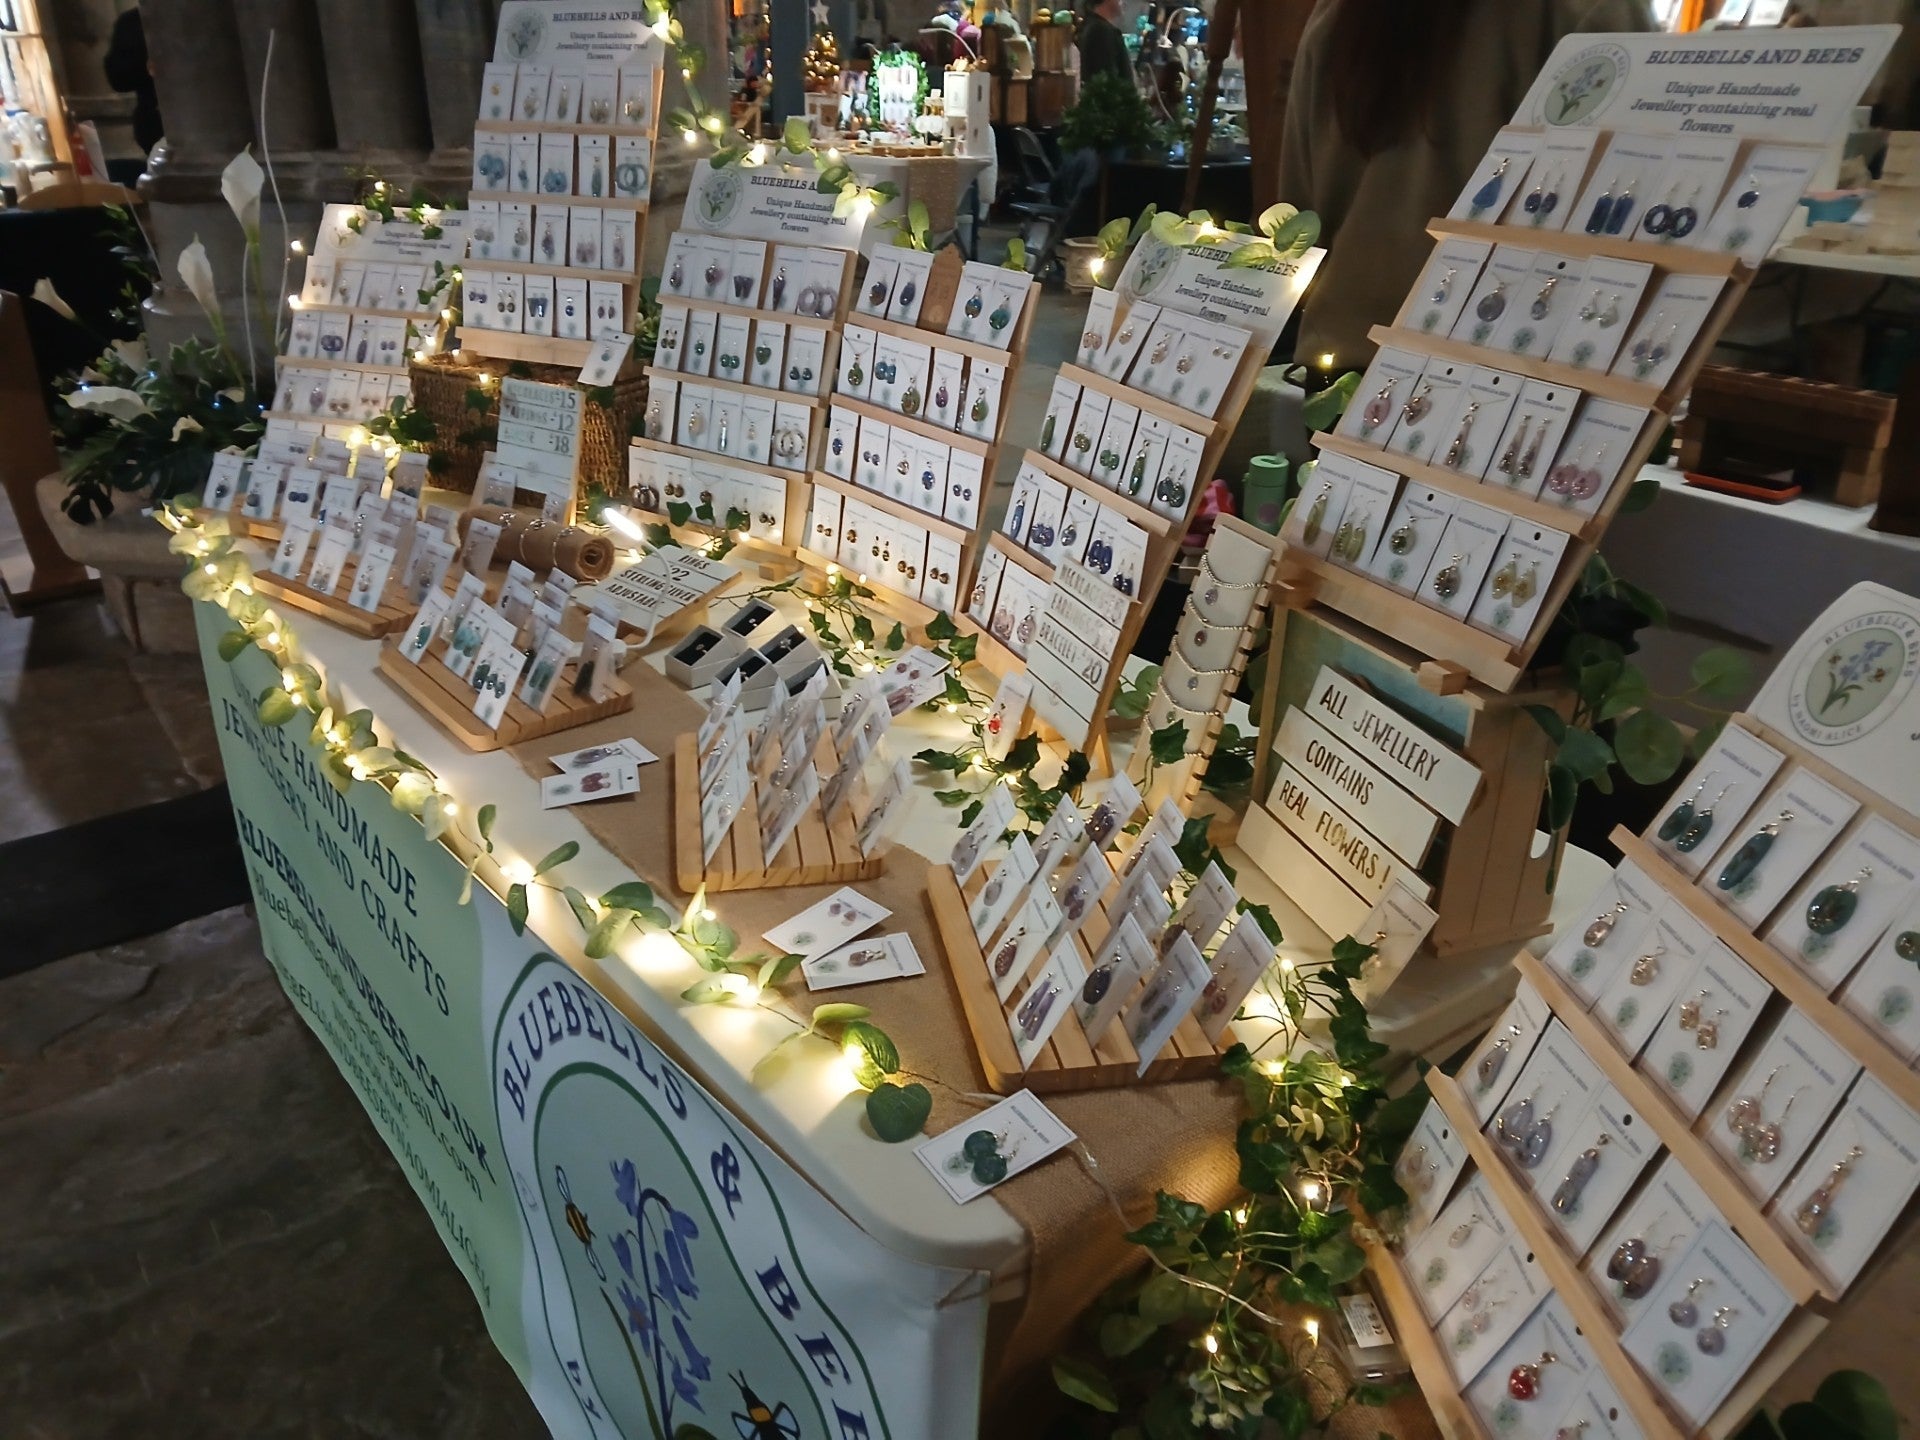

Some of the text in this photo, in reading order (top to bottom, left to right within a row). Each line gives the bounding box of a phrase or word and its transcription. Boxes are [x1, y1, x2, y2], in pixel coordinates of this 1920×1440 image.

[552, 11, 607, 22] BLUEBELLS
[609, 12, 630, 21] AND
[1645, 47, 1865, 65] BLUEBELLS AND BEES
[1665, 81, 1802, 98] Unique Handmade
[1631, 98, 1816, 119] Jewellery containing real
[1679, 119, 1734, 134] flowers
[751, 175, 807, 190] BLUEBELLS
[766, 196, 834, 213] Unique Handmad
[750, 206, 786, 220] Jewellery
[787, 211, 831, 226] containing
[780, 221, 809, 233] flowers
[1188, 246, 1233, 262] BLUEBEL
[1194, 273, 1265, 299] Unique Handmade
[606, 583, 665, 609] ADJUSTABL
[1319, 684, 1441, 782] ALL JEWELLERY
[1306, 739, 1374, 806] CONTAINS
[291, 740, 418, 917] HANDMADE
[1279, 779, 1310, 821] REAL
[1315, 810, 1379, 880] FLOWERS
[315, 819, 355, 892] AND
[361, 878, 450, 1017] CRAFTS
[503, 980, 688, 1122] BLUEBELLS
[710, 1142, 743, 1221] &
